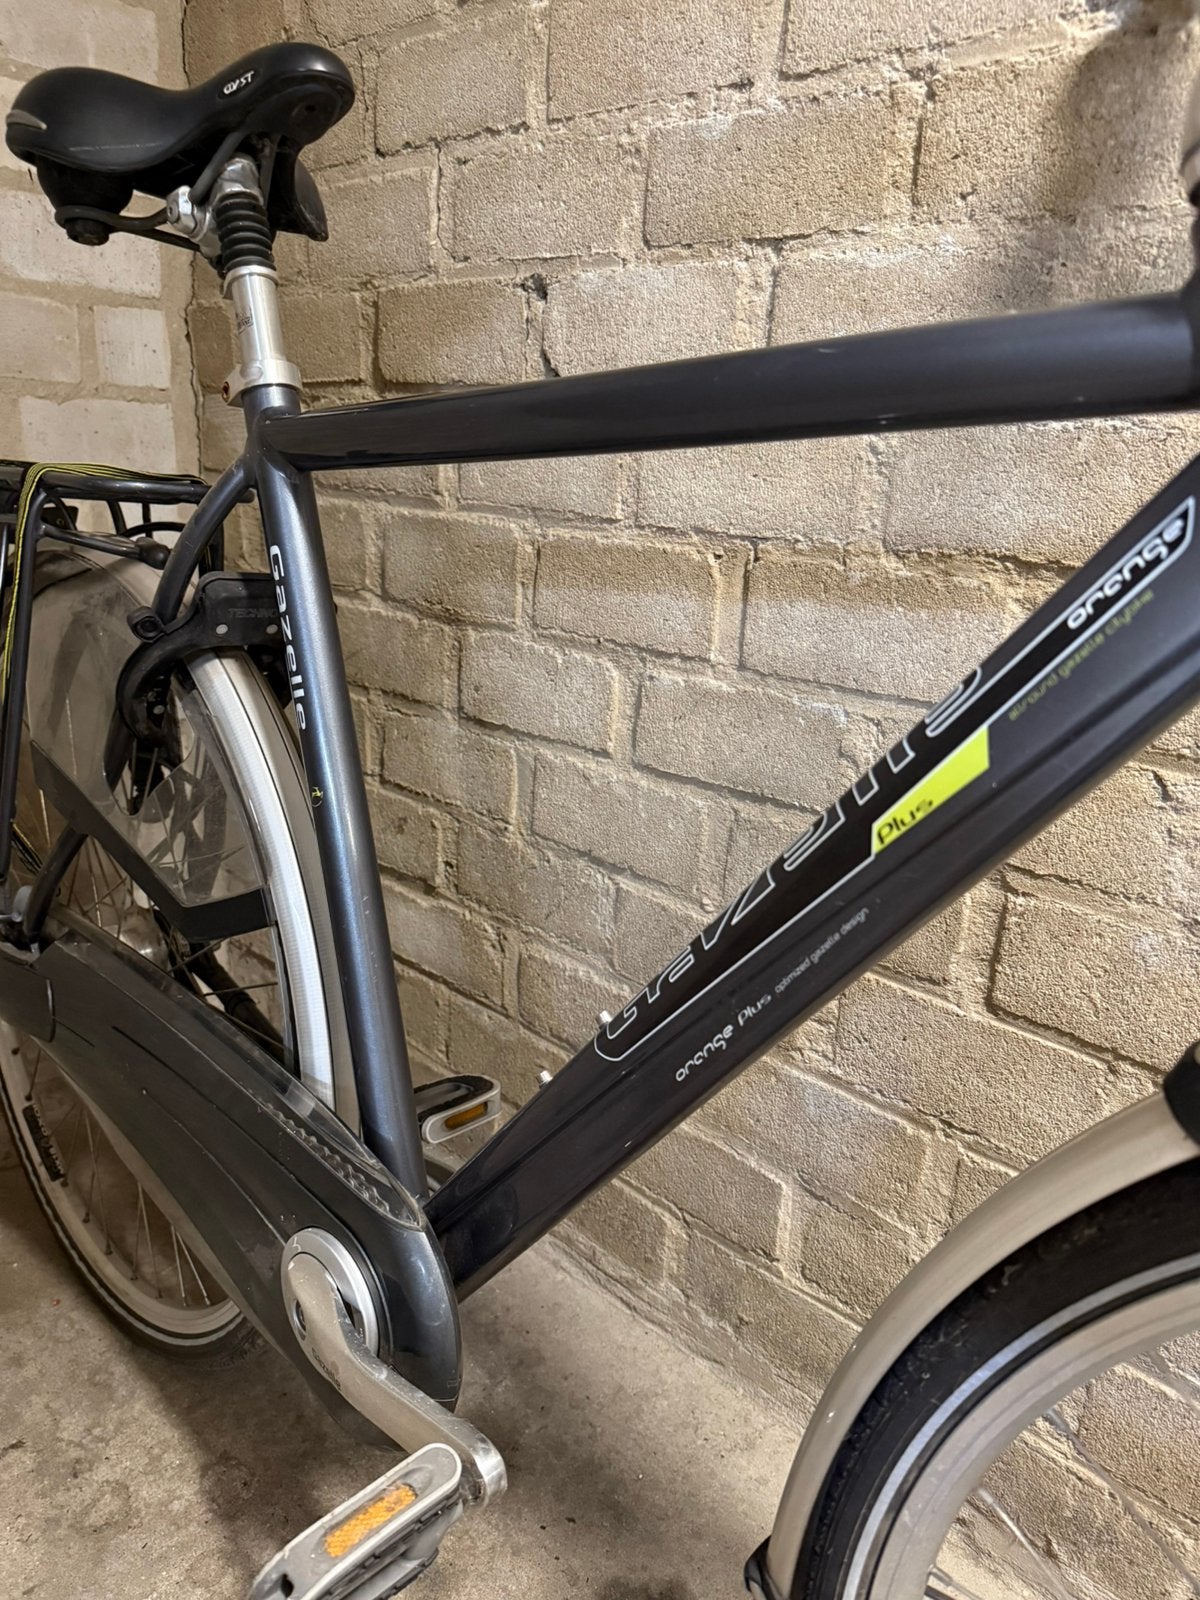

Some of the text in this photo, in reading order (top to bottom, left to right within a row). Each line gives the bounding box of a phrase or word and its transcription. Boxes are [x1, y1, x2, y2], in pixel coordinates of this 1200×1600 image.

[270, 545, 306, 730] Gazelle
[1067, 518, 1184, 630] orange
[877, 799, 933, 845] Plus
[675, 907, 870, 1082] orange Plus optimized gazelle design
